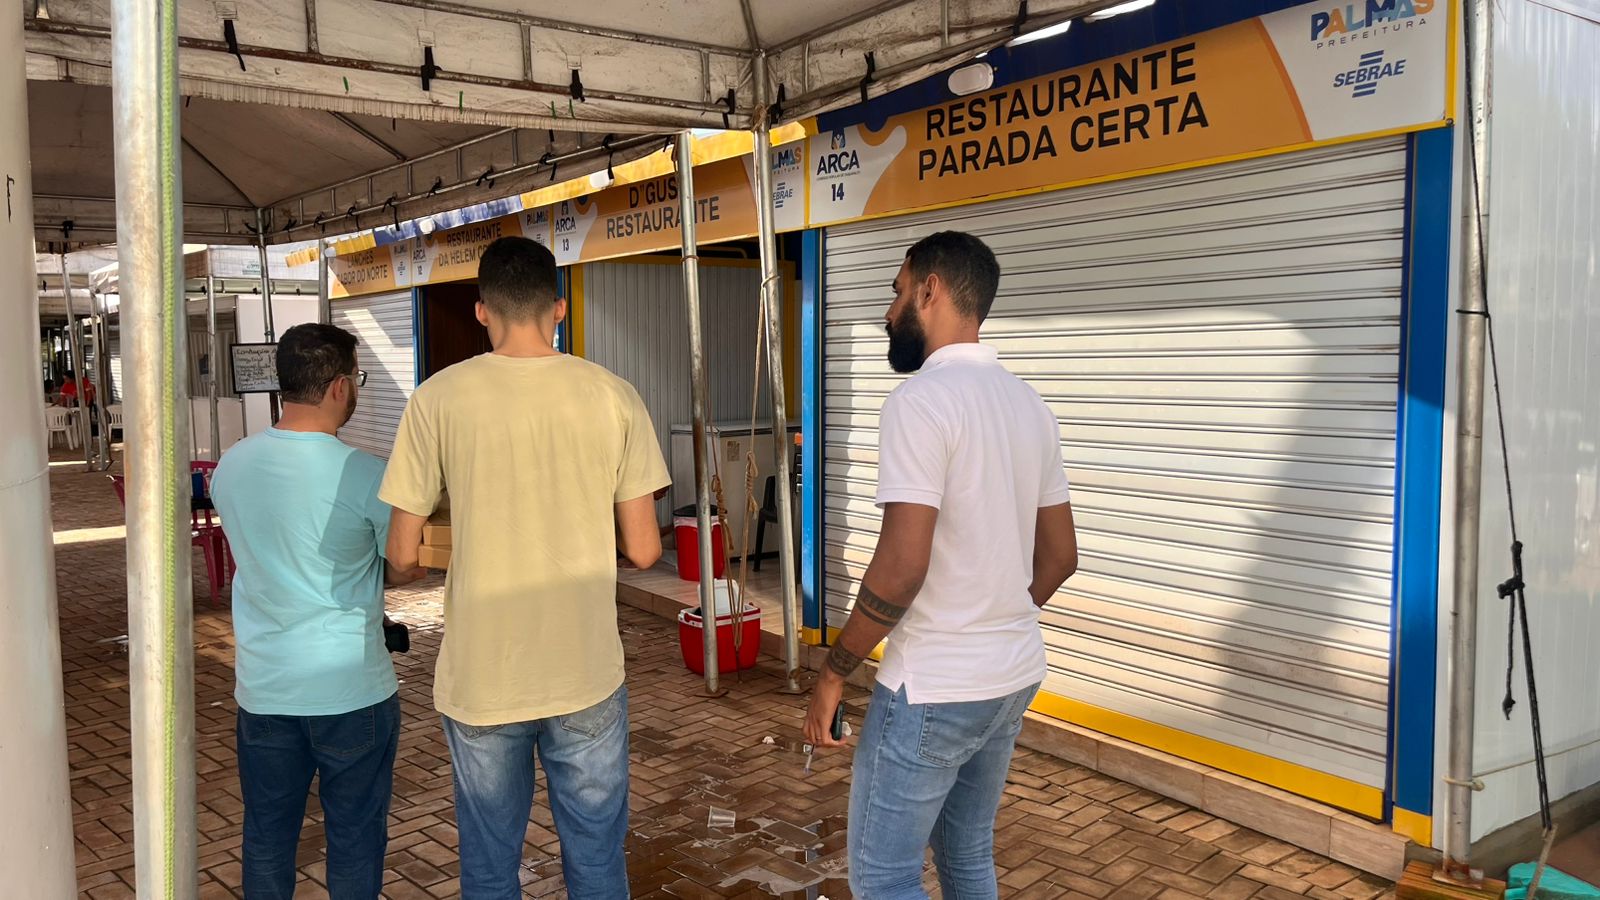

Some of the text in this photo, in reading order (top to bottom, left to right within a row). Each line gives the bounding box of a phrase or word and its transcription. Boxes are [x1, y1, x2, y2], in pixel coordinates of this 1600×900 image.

[1310, 0, 1435, 41] PALMAS
[1316, 17, 1427, 50] PREFEITURA
[1333, 59, 1407, 88] SEBRAE
[926, 42, 1196, 141] RESTAURANTE
[918, 91, 1209, 180] PARADA CERTA
[772, 146, 802, 171] LMAS
[816, 149, 860, 176] ARCA
[629, 176, 679, 209] D"GUS
[772, 188, 793, 201] EBRAE
[831, 182, 845, 202] 14
[447, 222, 501, 248] RESTAURANTE
[555, 216, 577, 233] ARCA
[562, 238, 570, 252] 13
[438, 252, 450, 266] DA
[367, 264, 388, 281] NORTE
